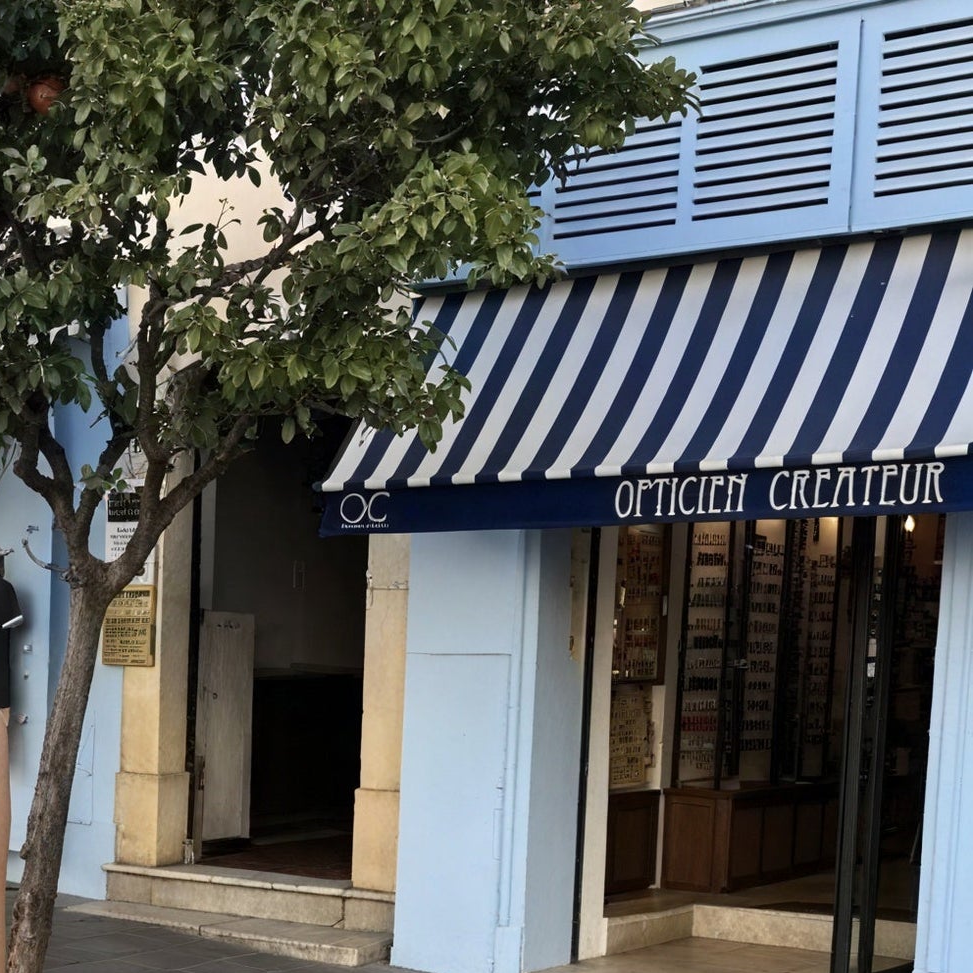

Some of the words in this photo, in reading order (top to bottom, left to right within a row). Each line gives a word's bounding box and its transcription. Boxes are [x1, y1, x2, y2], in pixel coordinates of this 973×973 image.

[340, 491, 390, 524] OC
[614, 473, 749, 518] OPTICIEN
[768, 462, 945, 511] CREATEUR
